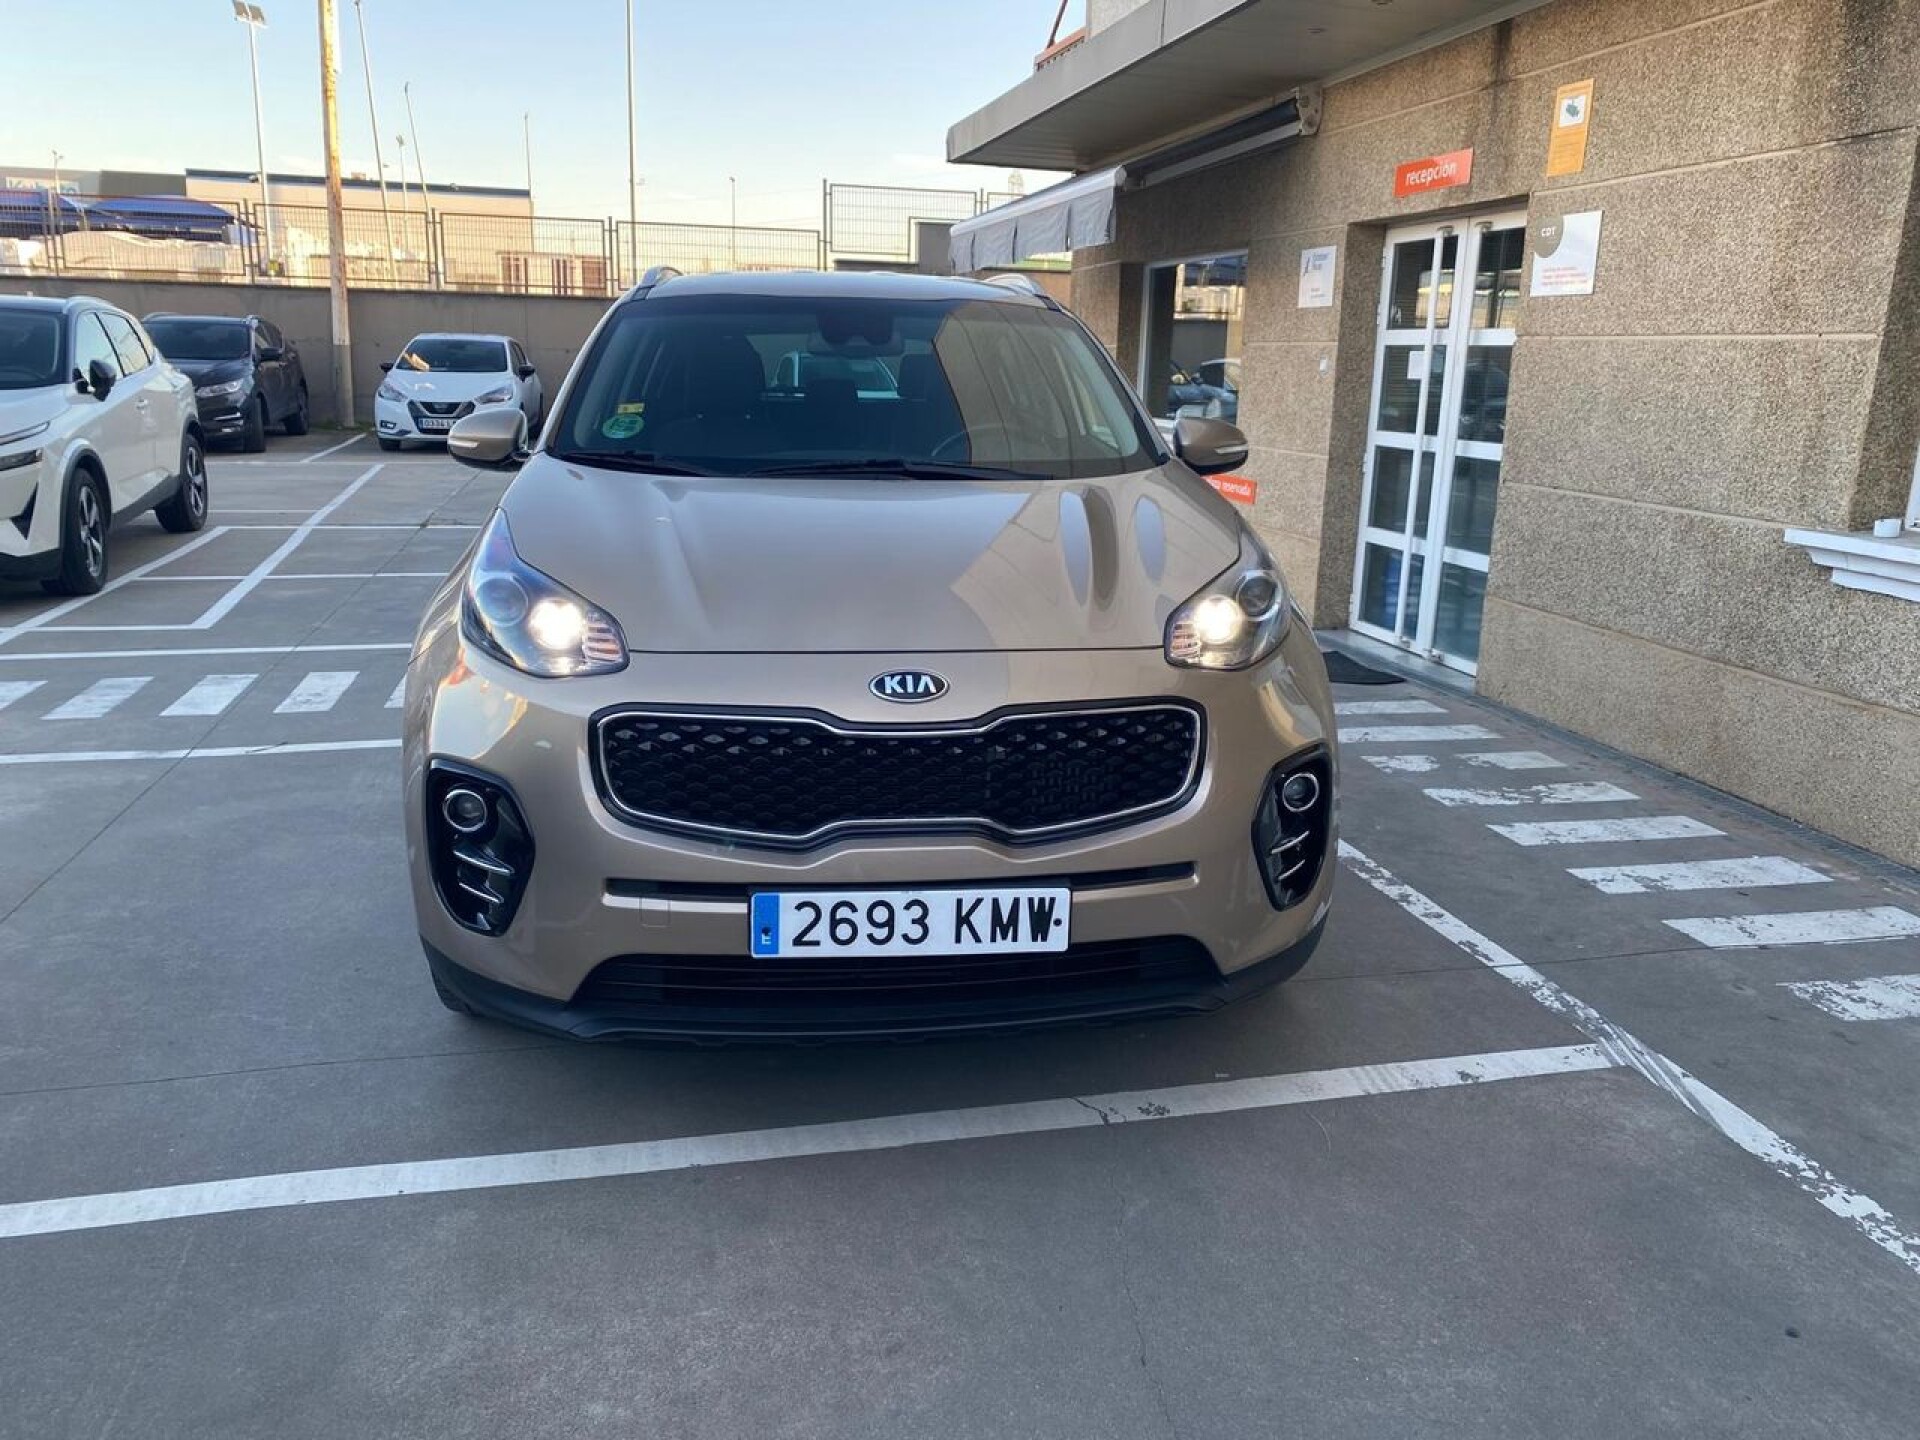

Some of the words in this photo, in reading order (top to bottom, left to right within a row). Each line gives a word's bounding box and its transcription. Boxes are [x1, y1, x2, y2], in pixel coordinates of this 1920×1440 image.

[1405, 162, 1457, 187] recepción
[884, 674, 937, 694] KIA
[792, 898, 930, 947] 2693
[954, 896, 1057, 945] KMW
